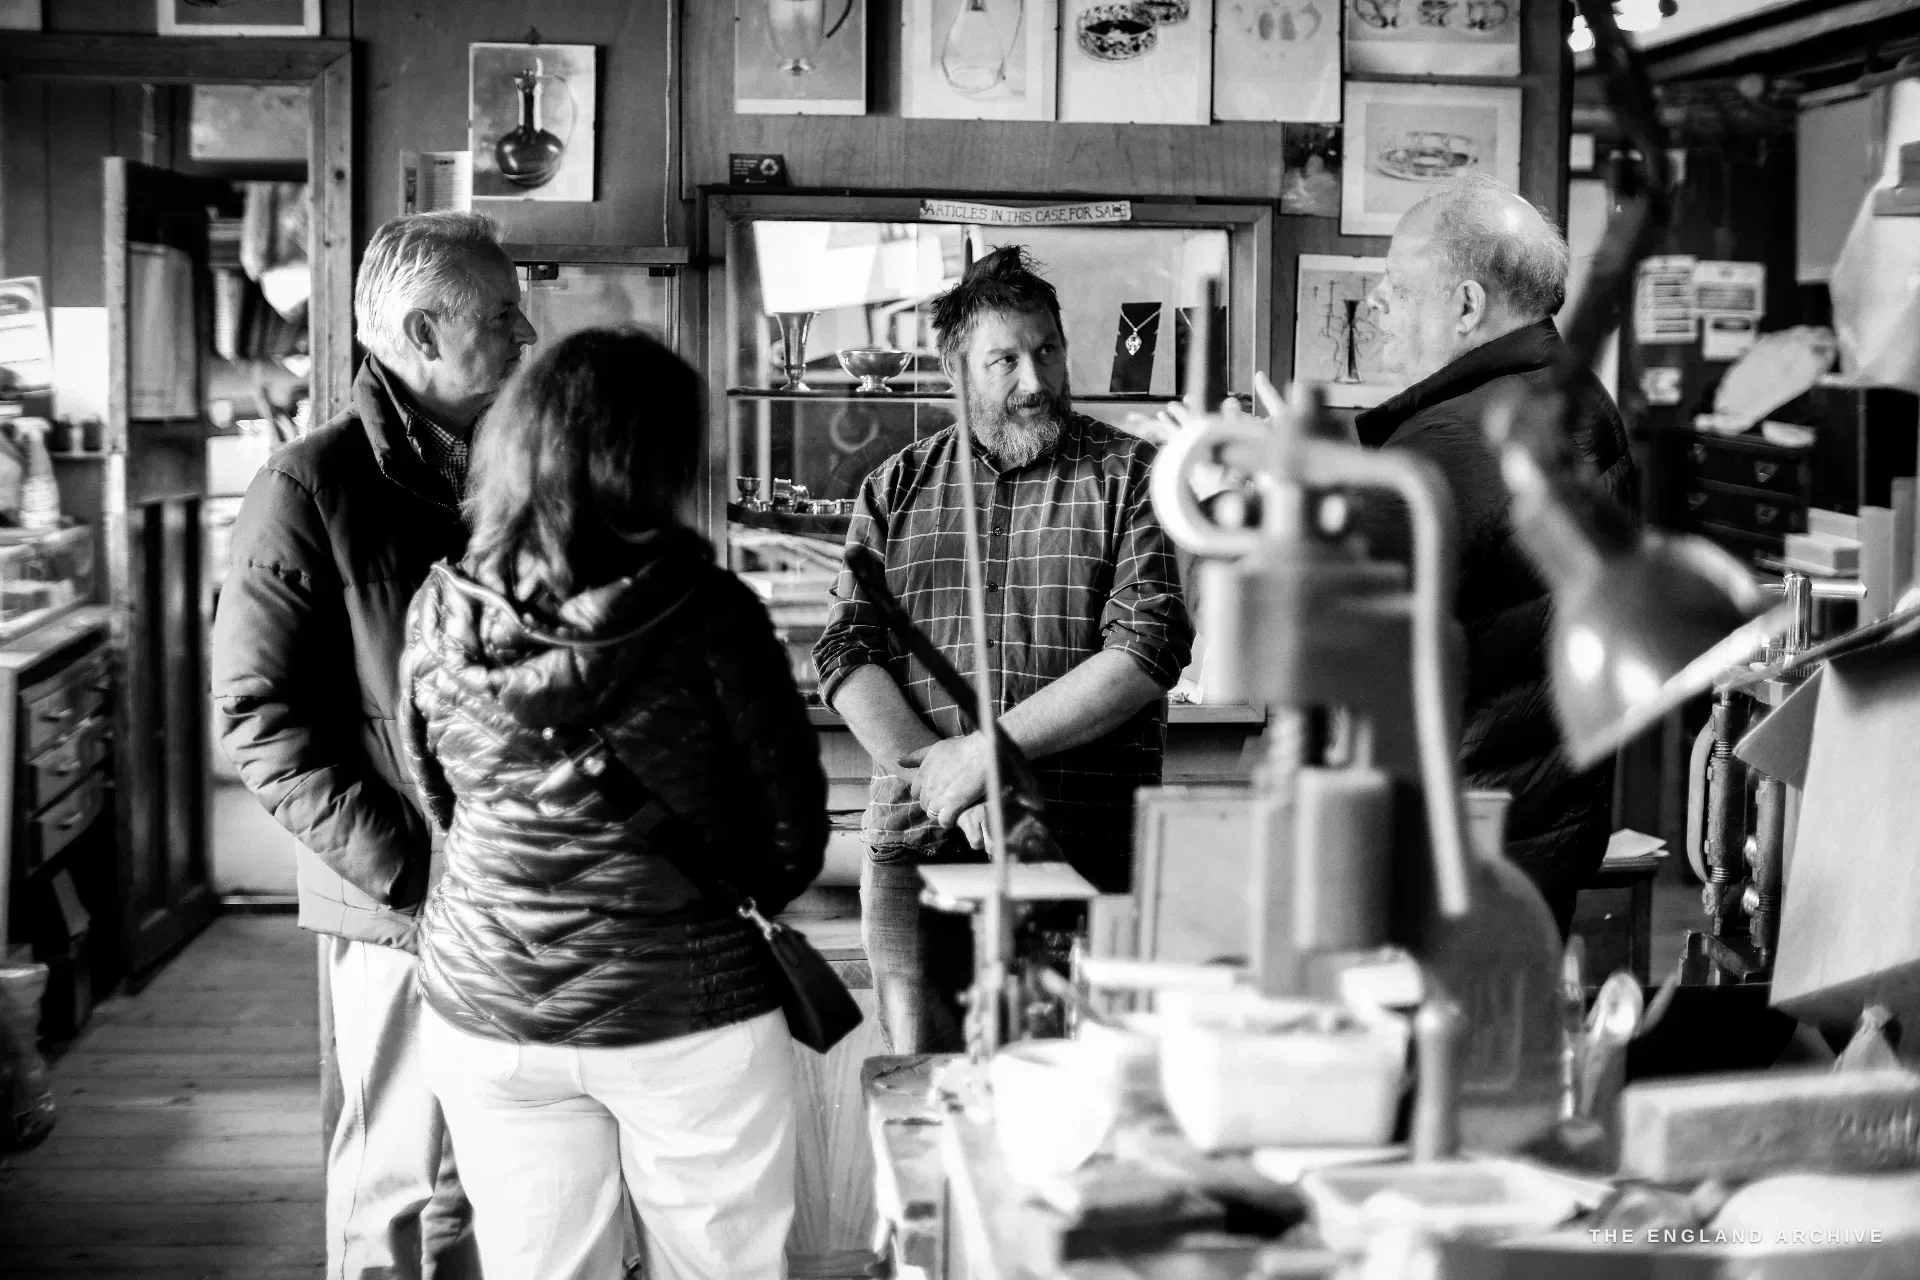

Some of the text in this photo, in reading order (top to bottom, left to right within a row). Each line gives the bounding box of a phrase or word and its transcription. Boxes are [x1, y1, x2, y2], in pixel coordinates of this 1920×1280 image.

[924, 203, 1128, 223] ARTICLES IN THIS CASE FOR SALE
